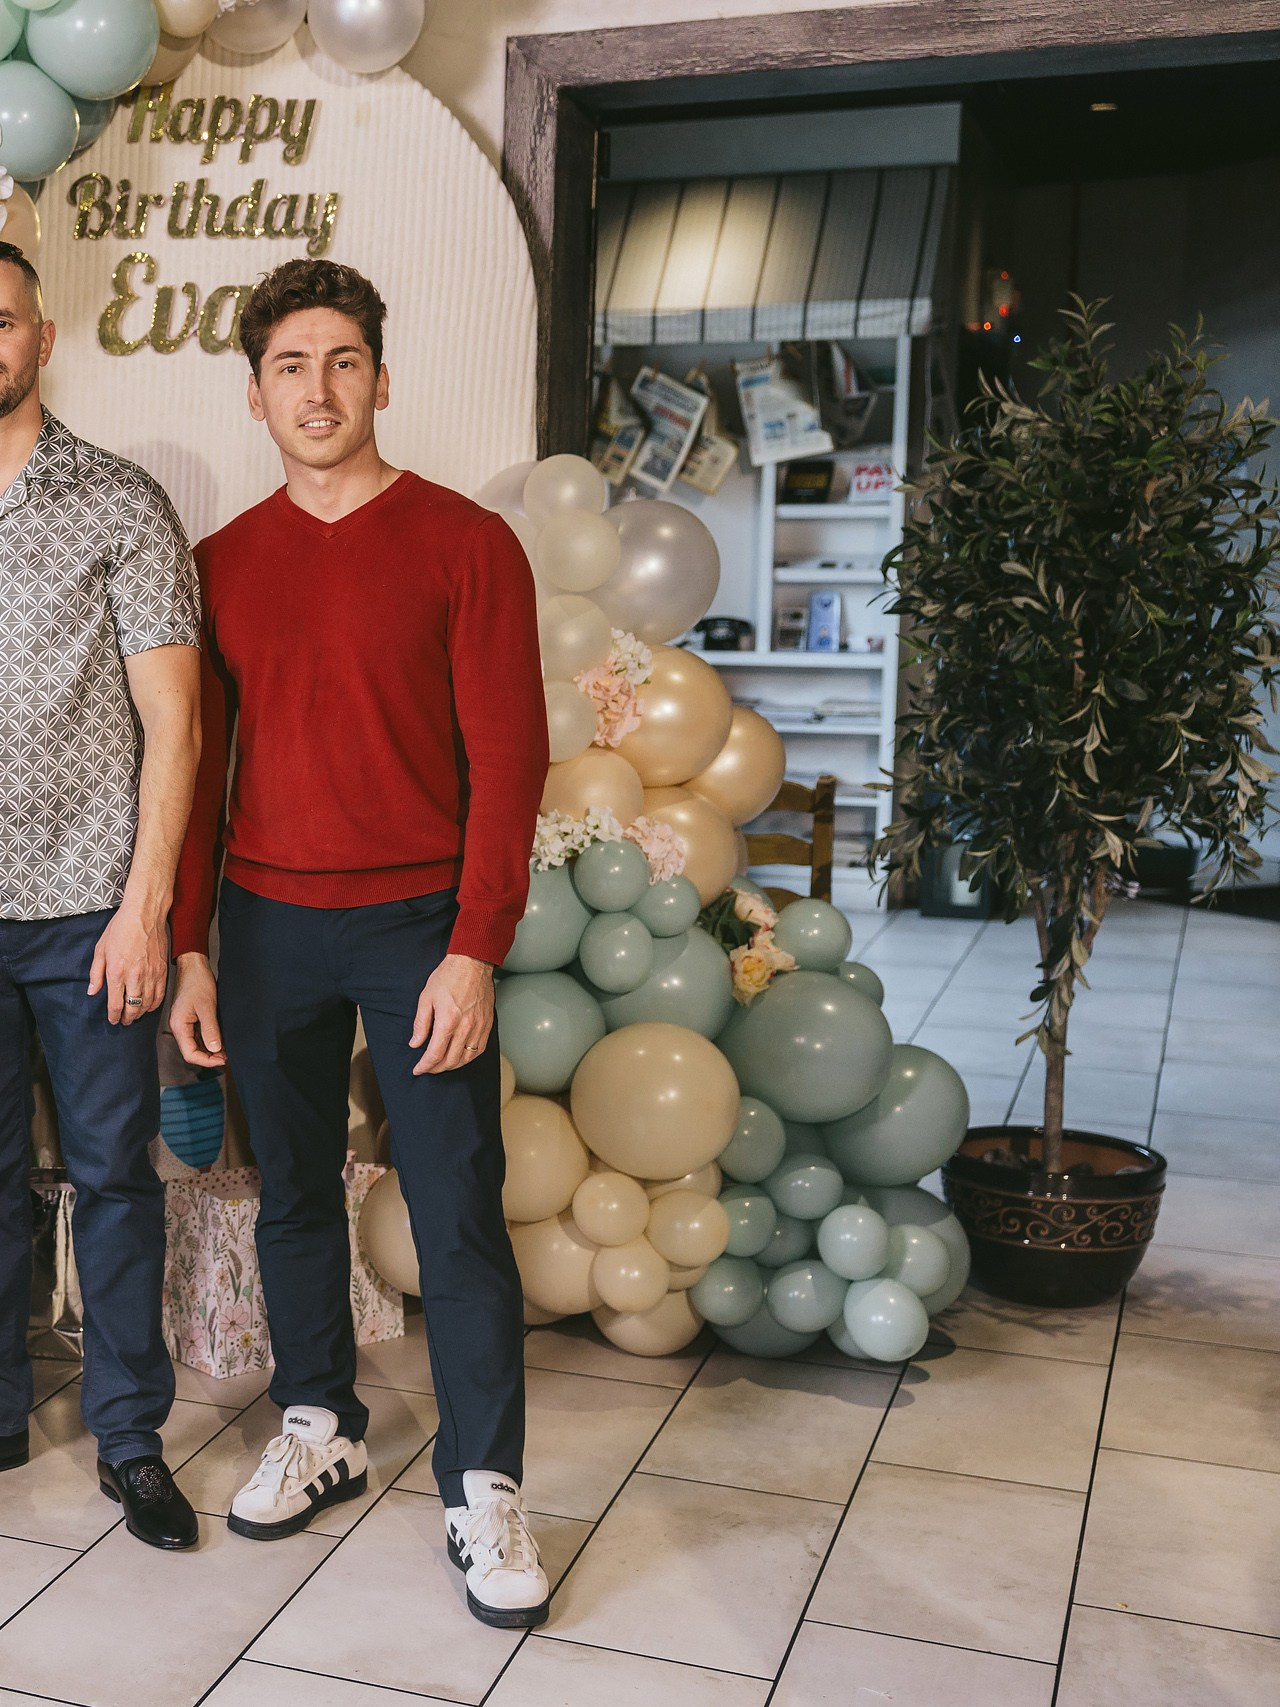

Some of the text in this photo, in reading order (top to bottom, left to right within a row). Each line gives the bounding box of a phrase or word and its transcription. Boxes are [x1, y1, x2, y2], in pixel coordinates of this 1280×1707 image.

[126, 81, 318, 166] Happy
[66, 171, 339, 257] Birthday
[97, 251, 257, 356] Eva
[287, 1416, 312, 1427] adidas
[490, 1482, 516, 1495] adidas
